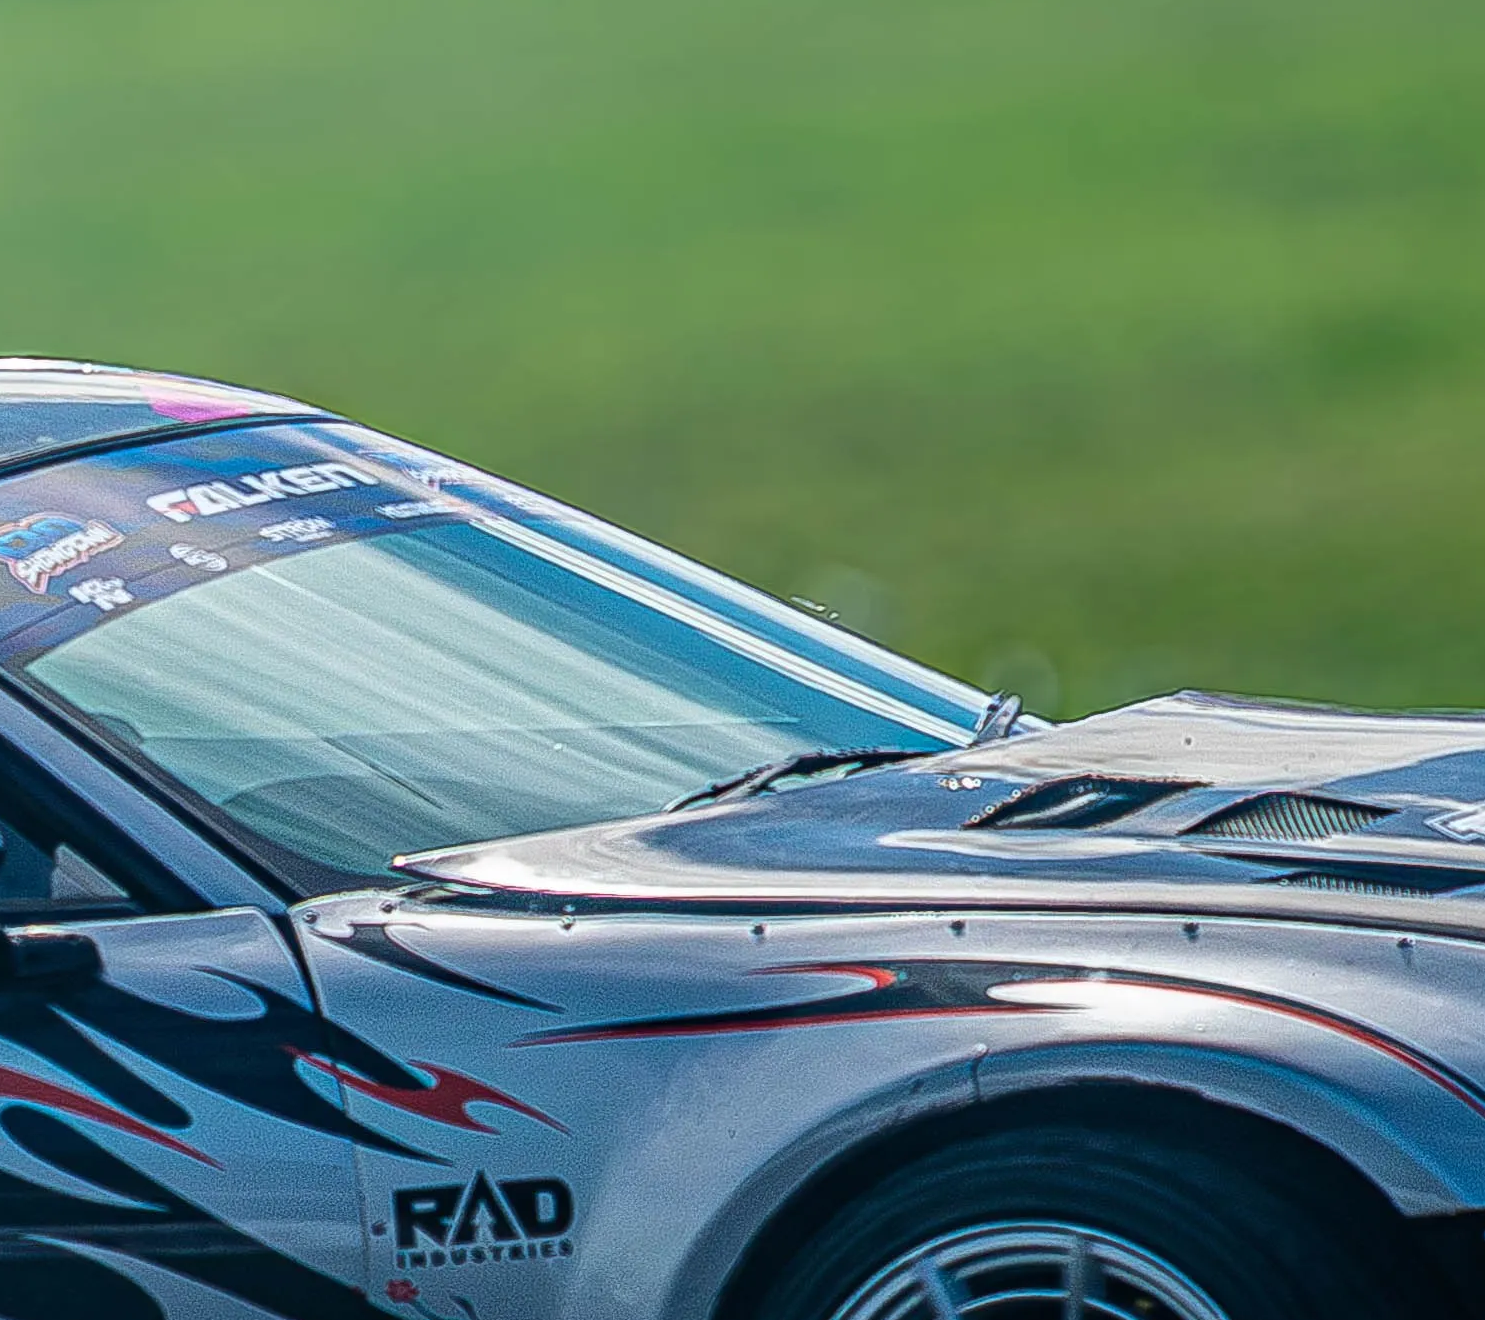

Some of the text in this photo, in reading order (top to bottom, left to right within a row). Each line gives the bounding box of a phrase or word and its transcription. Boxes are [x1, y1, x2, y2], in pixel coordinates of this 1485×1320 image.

[145, 462, 378, 522] FALKEN
[393, 1169, 575, 1249] RAD
[395, 1237, 575, 1270] INDUSTRIES
